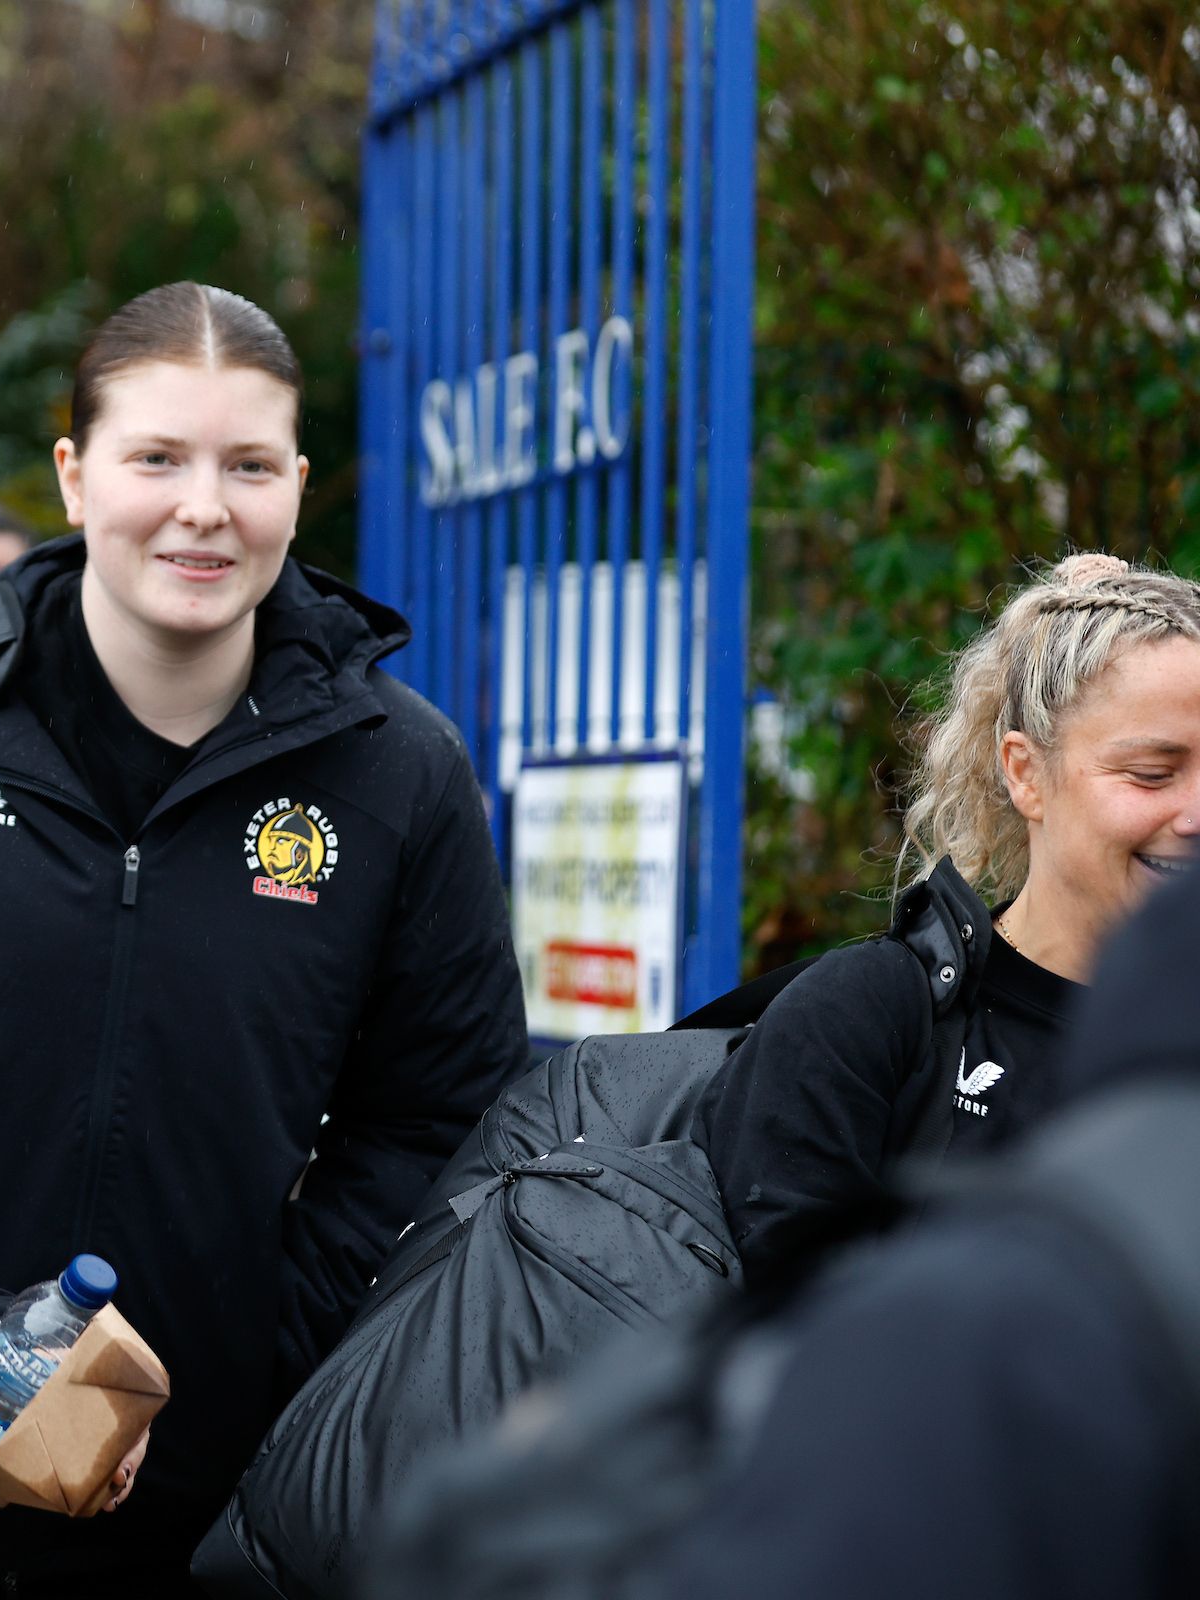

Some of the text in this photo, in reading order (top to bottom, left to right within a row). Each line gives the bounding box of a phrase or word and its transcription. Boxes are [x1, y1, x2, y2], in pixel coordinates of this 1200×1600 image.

[419, 352, 538, 508] SALE
[244, 797, 338, 880] EXETER RUGBY
[253, 875, 318, 905] Chiefs
[952, 1094, 989, 1117] STORE
